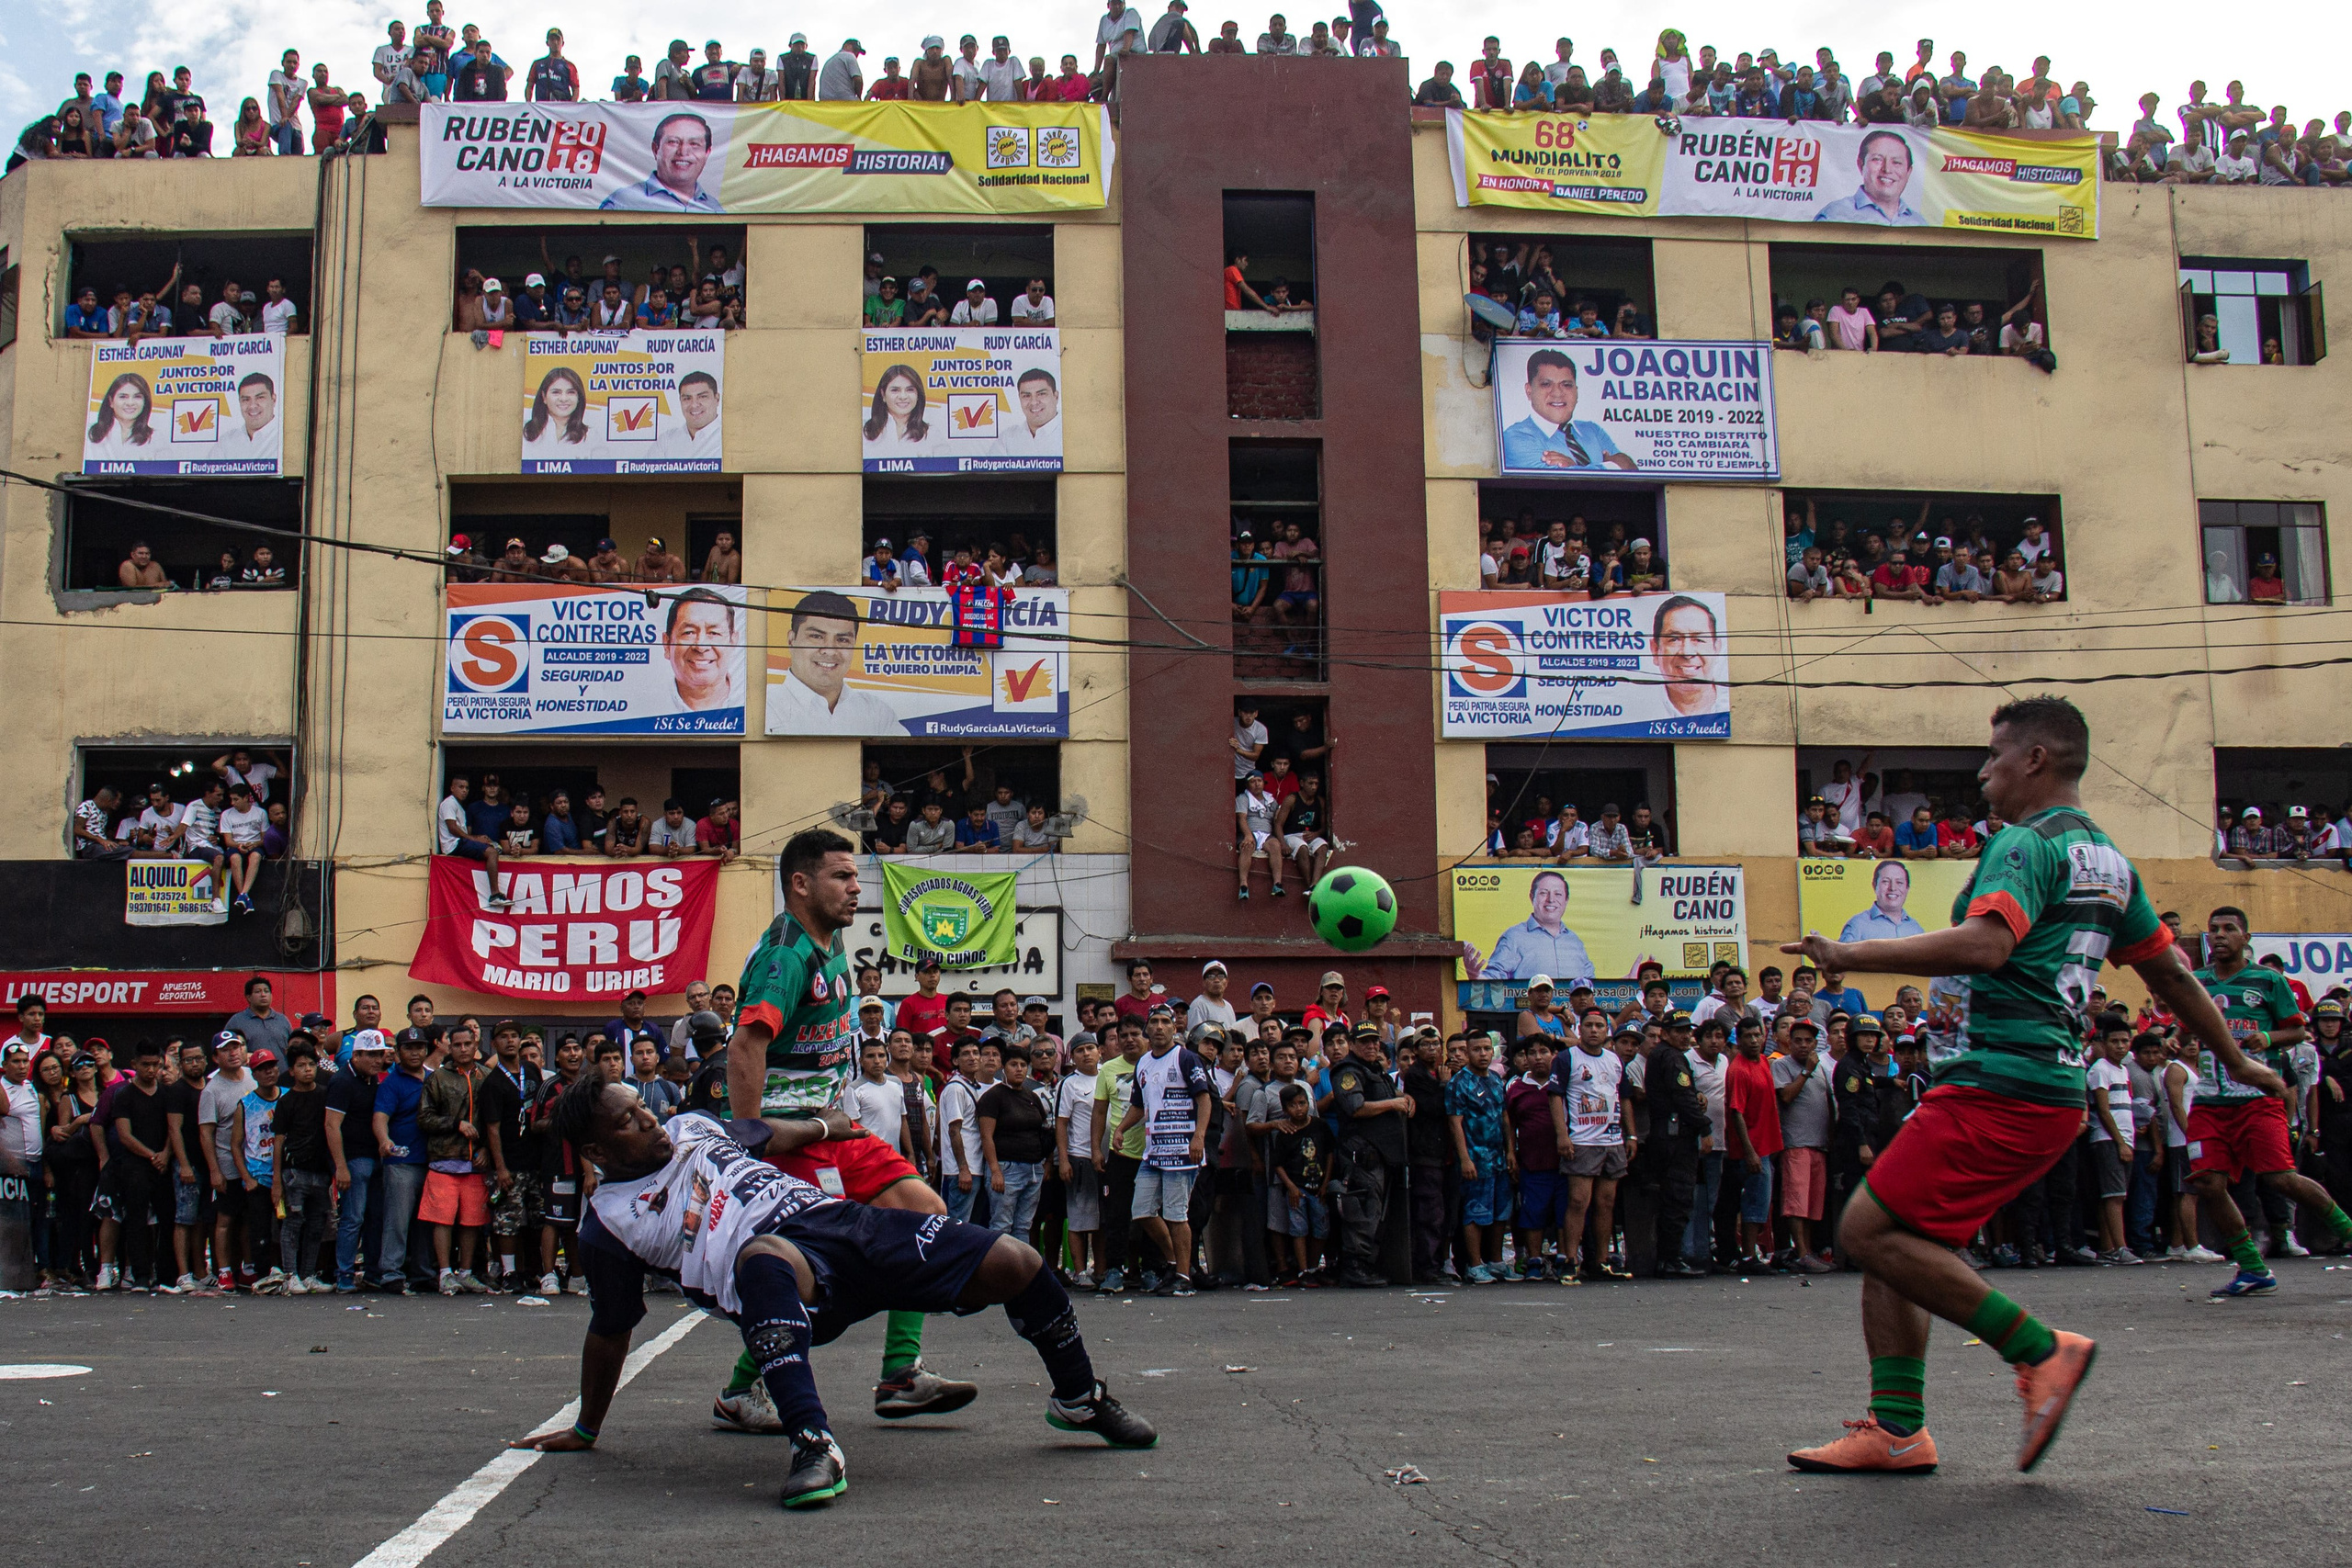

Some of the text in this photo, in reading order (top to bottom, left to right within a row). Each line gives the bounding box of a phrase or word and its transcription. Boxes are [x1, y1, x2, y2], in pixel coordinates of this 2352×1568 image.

[443, 112, 553, 143] RUBÉN
[558, 121, 602, 146] 20
[1535, 120, 1575, 149] 68
[1679, 129, 1772, 160] RUBÉN
[1779, 139, 1816, 163] 20
[457, 146, 545, 172] CANO
[552, 149, 594, 174] 18
[753, 147, 944, 171] ¡HAGAMOS HISTORIA!
[1491, 149, 1621, 169] MUNDIALITO
[1558, 168, 1599, 177] PORVENIR
[1600, 170, 1622, 178] 2018
[1694, 160, 1770, 184] CANO
[1779, 165, 1813, 188] 18
[1947, 158, 2078, 182] ¡HAGAMOS HISTORIA!
[498, 178, 593, 189] A LA VICTORIA
[978, 174, 1090, 186] Solidaridad Nacional
[1482, 176, 1497, 186] EN
[1499, 178, 1540, 189] HONOR
[1556, 187, 1595, 199] DANIEL
[1599, 189, 1644, 202] PEREDO
[1734, 187, 1814, 202] A LA VICTORIA
[1959, 215, 2054, 231] Solidaridad Nacional
[209, 338, 273, 356] RUDY GARCÍA
[529, 340, 619, 355] ESTHER CAPUNAY
[647, 336, 715, 353] RUDY GARCÍA
[866, 337, 956, 351] ESTHER CAPUNAY
[984, 333, 1052, 350] RUDY GARCÍA
[98, 345, 185, 361] ESTHER CAPUNAY
[592, 363, 674, 374] JUNTOS POR
[930, 360, 1012, 371] JUNTOS POR
[1584, 348, 1759, 380] JOAQUIN
[159, 366, 234, 378] JUNTOS POR
[155, 381, 235, 394] LA VICTORIA
[590, 379, 675, 390] LA VICTORIA
[929, 376, 1014, 388] LA VICTORIA
[1601, 380, 1758, 402] ALBARRACIN
[1603, 409, 1764, 423] ALCALDE 2019 2022
[100, 463, 135, 473] LIMA
[537, 462, 571, 473] LIMA
[879, 460, 914, 471] LIMA
[1717, 460, 1770, 468] EJEMPLO
[552, 601, 645, 621] VICTOR
[868, 600, 948, 626] RUDY
[1543, 608, 1632, 627] VICTOR
[537, 624, 657, 644] CONTRERAS
[1531, 630, 1645, 650] CONTRERAS
[546, 652, 647, 661] ALCALDE 2019 2022
[864, 644, 981, 664] LA VICTORIA,
[865, 664, 981, 675] TE QUIERO LIMPIA.
[1541, 659, 1585, 667] ALCALDE
[1588, 659, 1608, 667] 2019
[540, 670, 624, 682] SEGURIDAD
[1538, 675, 1617, 687] SEGURIDAD
[579, 685, 587, 696] Y
[1575, 690, 1583, 701] Y
[447, 696, 531, 707] PERÚ PATRIA SEGURA
[536, 700, 628, 712] HONESTIDAD
[1449, 701, 1530, 711] PERÚ PATRIA SEGURA
[446, 708, 532, 720] LA VICTORIA
[1447, 712, 1532, 724] LA VICTORIA
[1534, 705, 1623, 716] HONESTIDAD
[676, 717, 692, 730] Se
[695, 717, 738, 730] Puede!
[941, 724, 1055, 734] RudyGarciaALaVictoria
[1668, 723, 1683, 734] Se
[1686, 722, 1726, 734] Puede!
[130, 866, 187, 889] ALQUILO
[1660, 872, 1736, 897] RUBÉN
[151, 892, 187, 900] 4735724
[471, 868, 683, 914] VAMOS
[130, 903, 170, 912] 993701647
[952, 879, 979, 899] AGUAS
[975, 895, 993, 921] VERDES
[1673, 899, 1735, 920] CANO
[471, 910, 681, 966] PERÚ
[1640, 923, 1737, 939] ¡Hagamos historia!
[903, 943, 914, 958] EL
[917, 948, 944, 964] RICO
[947, 950, 986, 964] CUÑOC
[482, 964, 663, 993] MARIO URIBE
[6, 982, 148, 1003] LIVESPORT
[163, 982, 202, 991] APUESTAS
[159, 990, 206, 1000] DEPORTIVAS
[796, 1019, 837, 1042] LIZET
[2226, 1019, 2258, 1031] EYRA
